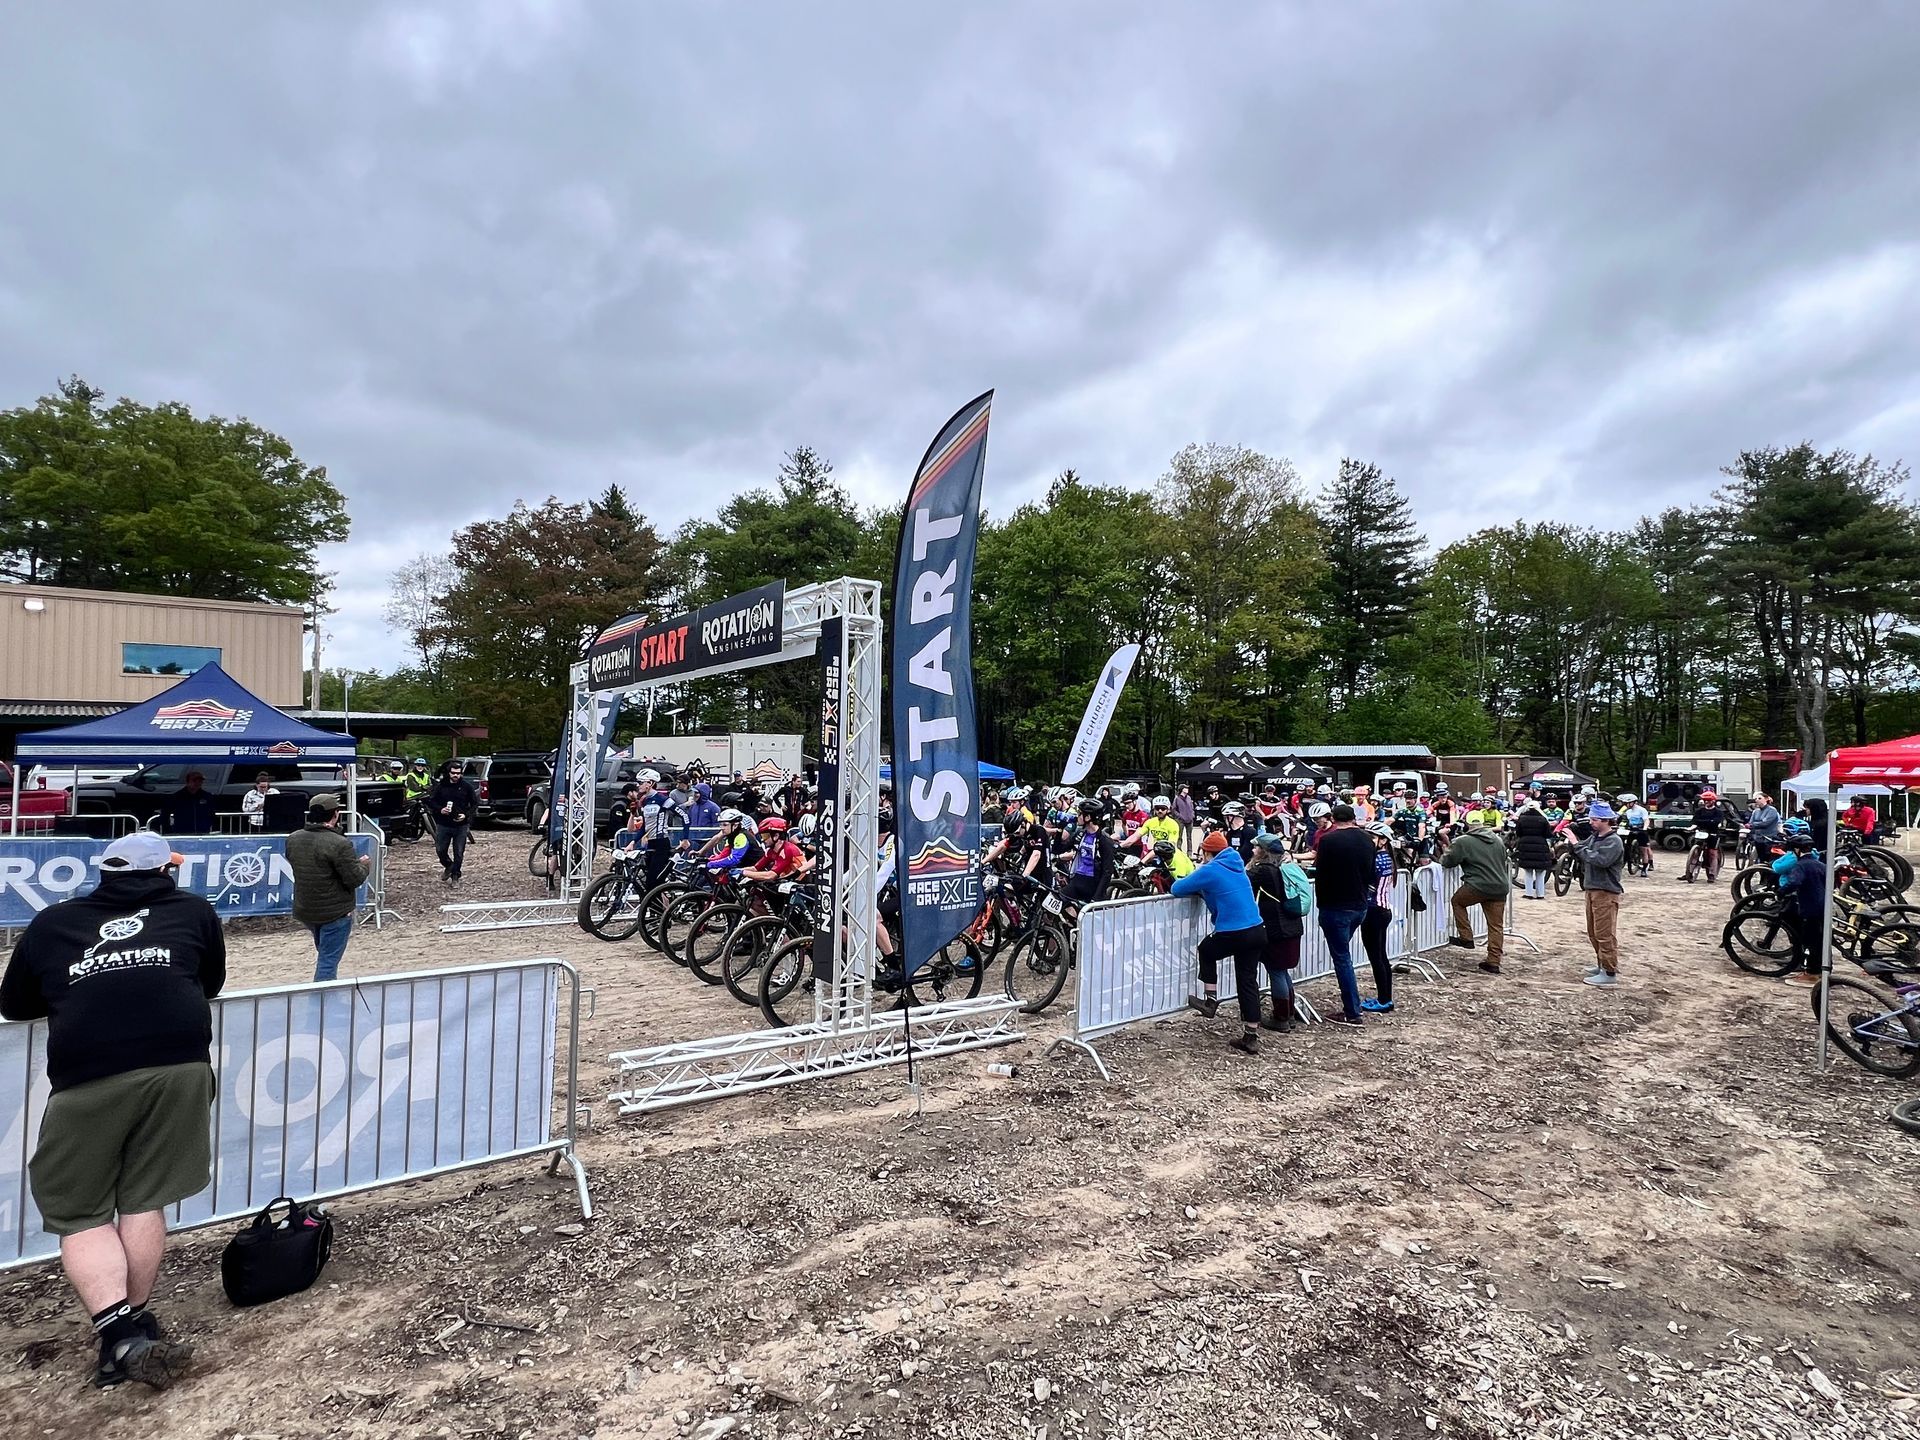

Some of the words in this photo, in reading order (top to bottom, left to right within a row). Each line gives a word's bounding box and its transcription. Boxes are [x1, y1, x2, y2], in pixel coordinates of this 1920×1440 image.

[702, 598, 774, 655] ROTATION
[640, 626, 689, 671] START
[714, 632, 774, 655] ENGINEERING
[591, 645, 631, 682] ROTATION
[908, 508, 969, 822] START
[1075, 739, 1089, 765] DIRT
[1086, 690, 1109, 735] CHURCH
[820, 799, 835, 933] ROTATION
[908, 880, 940, 894] RACE
[916, 893, 940, 906] DAY
[940, 876, 978, 904] XC
[1047, 898, 1061, 911] 106
[68, 947, 170, 976] ROTATION
